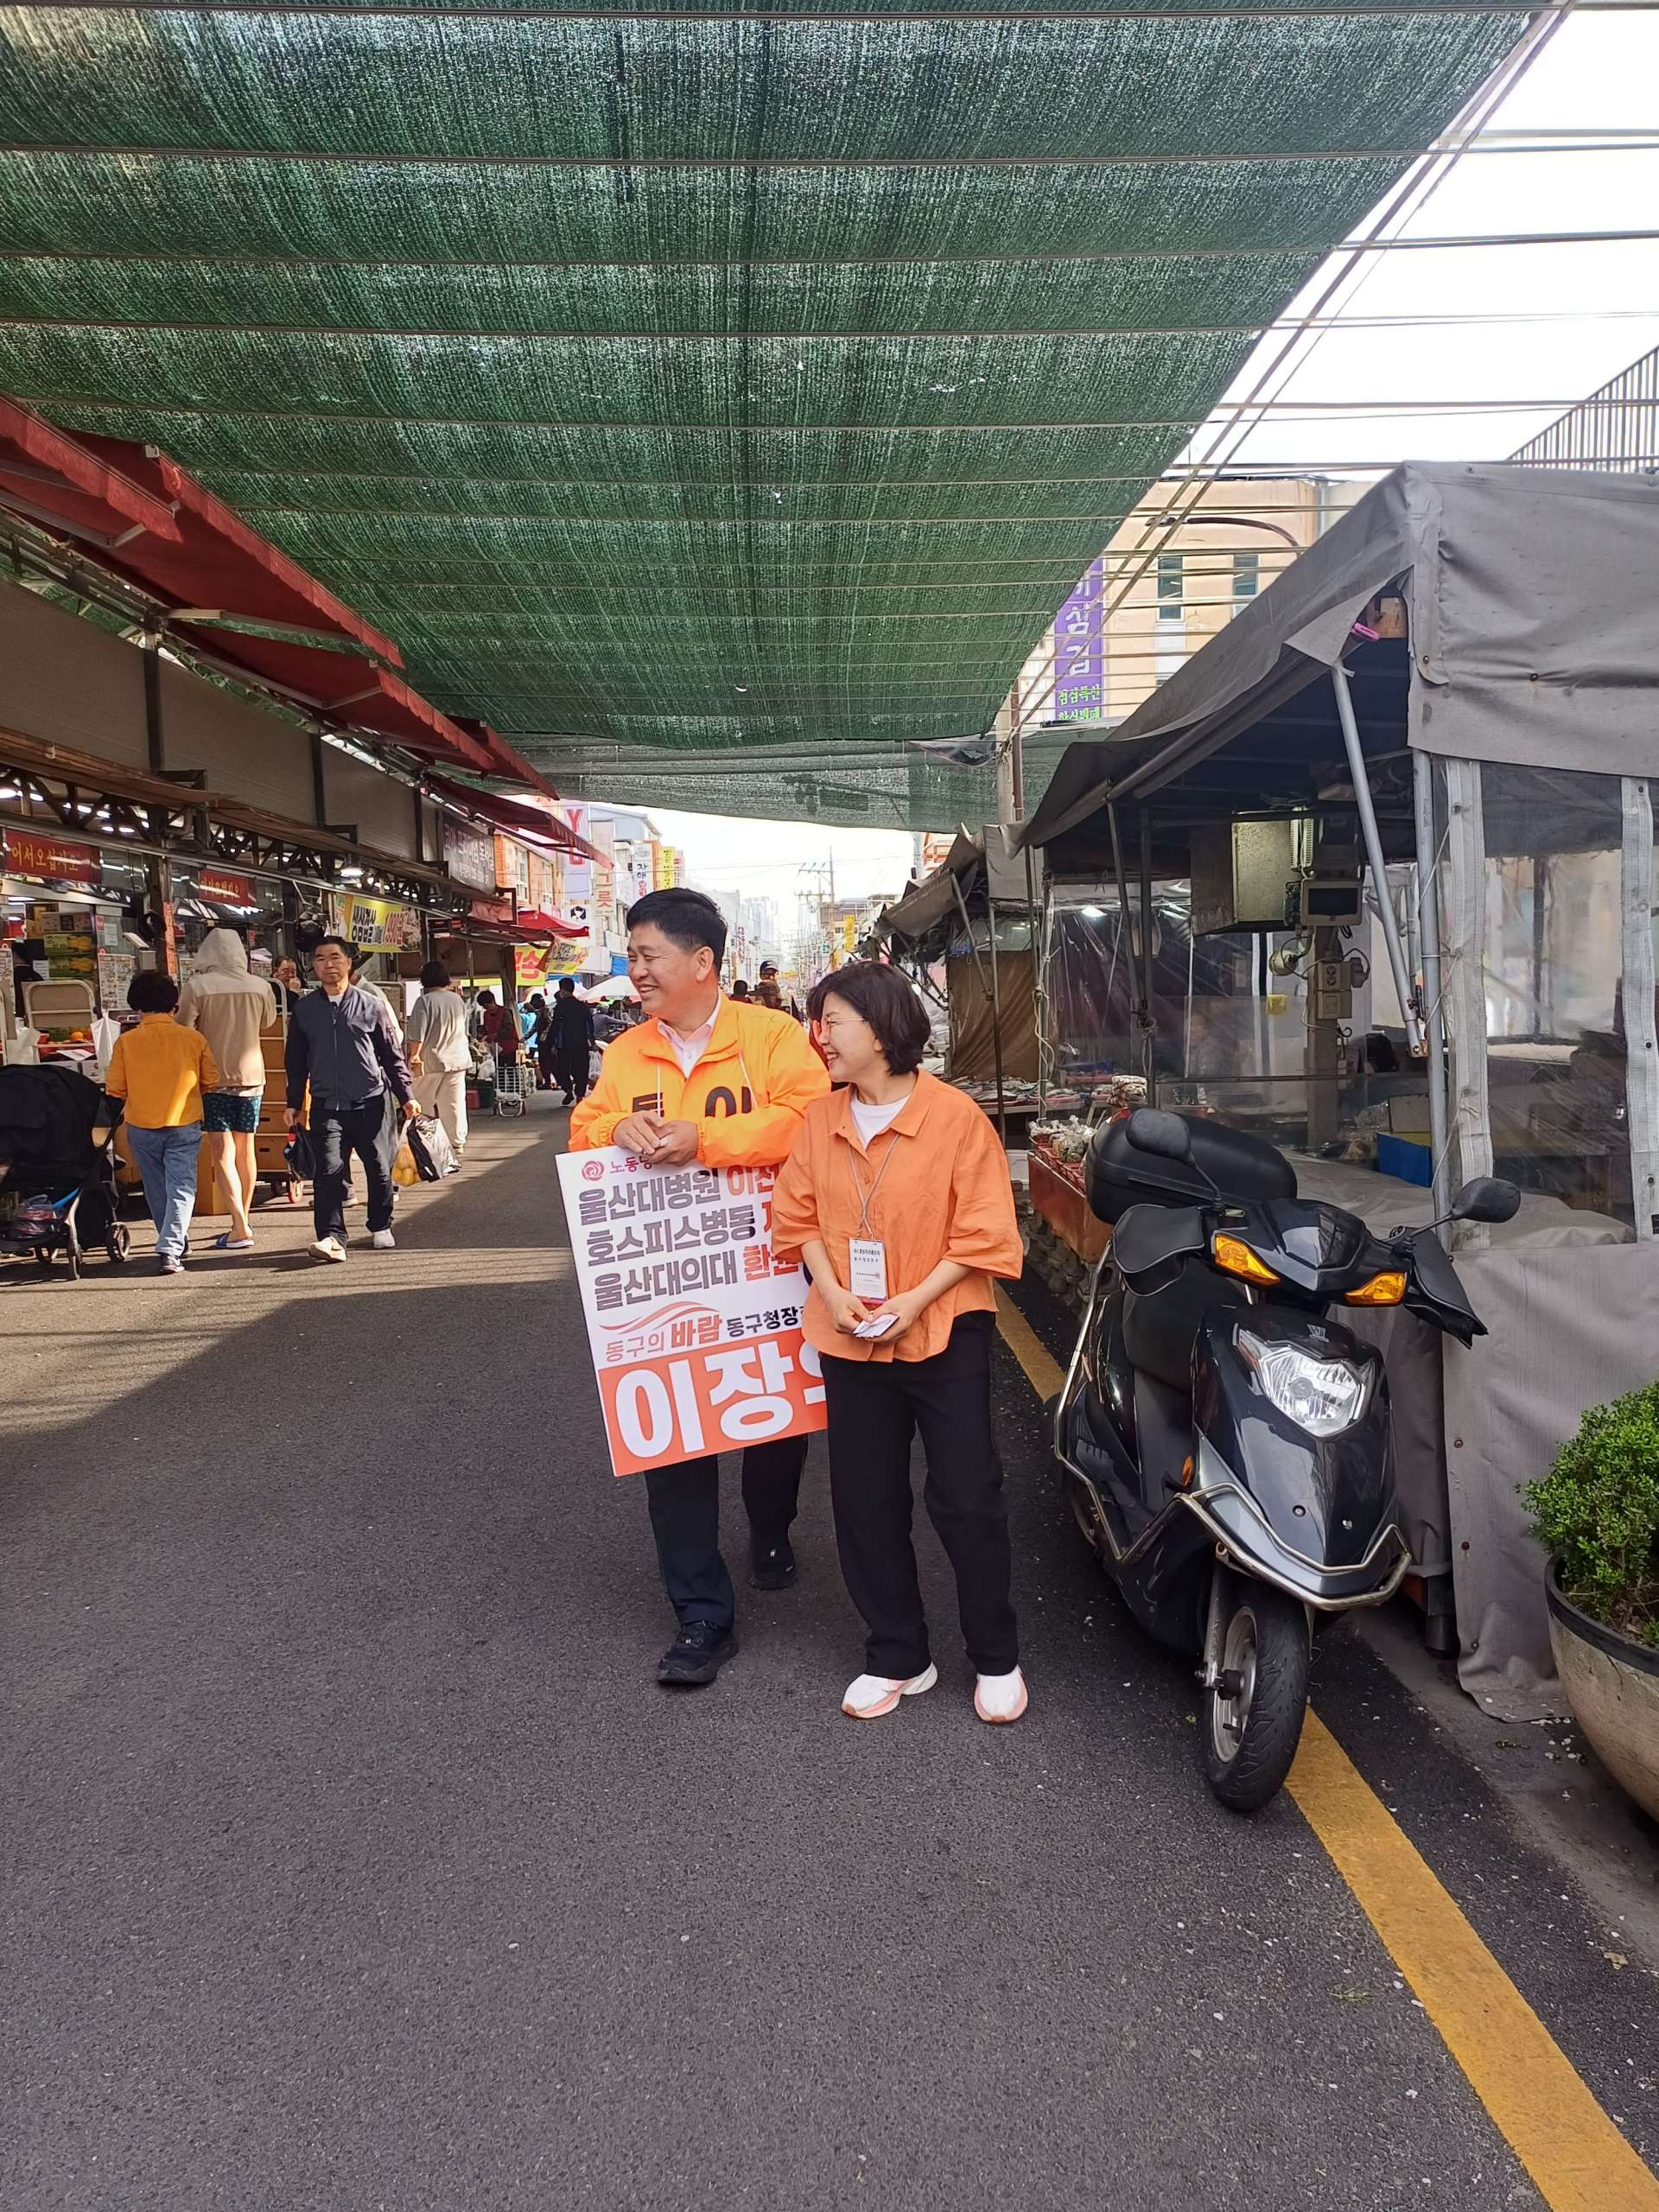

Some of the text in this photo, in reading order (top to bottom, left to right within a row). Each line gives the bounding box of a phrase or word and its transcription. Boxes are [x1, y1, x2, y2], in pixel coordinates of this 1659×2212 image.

[579, 1167, 721, 1225] 울산대병원
[588, 1202, 756, 1267] 호스피스병동
[594, 1248, 739, 1311] 울산대의대
[606, 1314, 723, 1363] 동구의 바람
